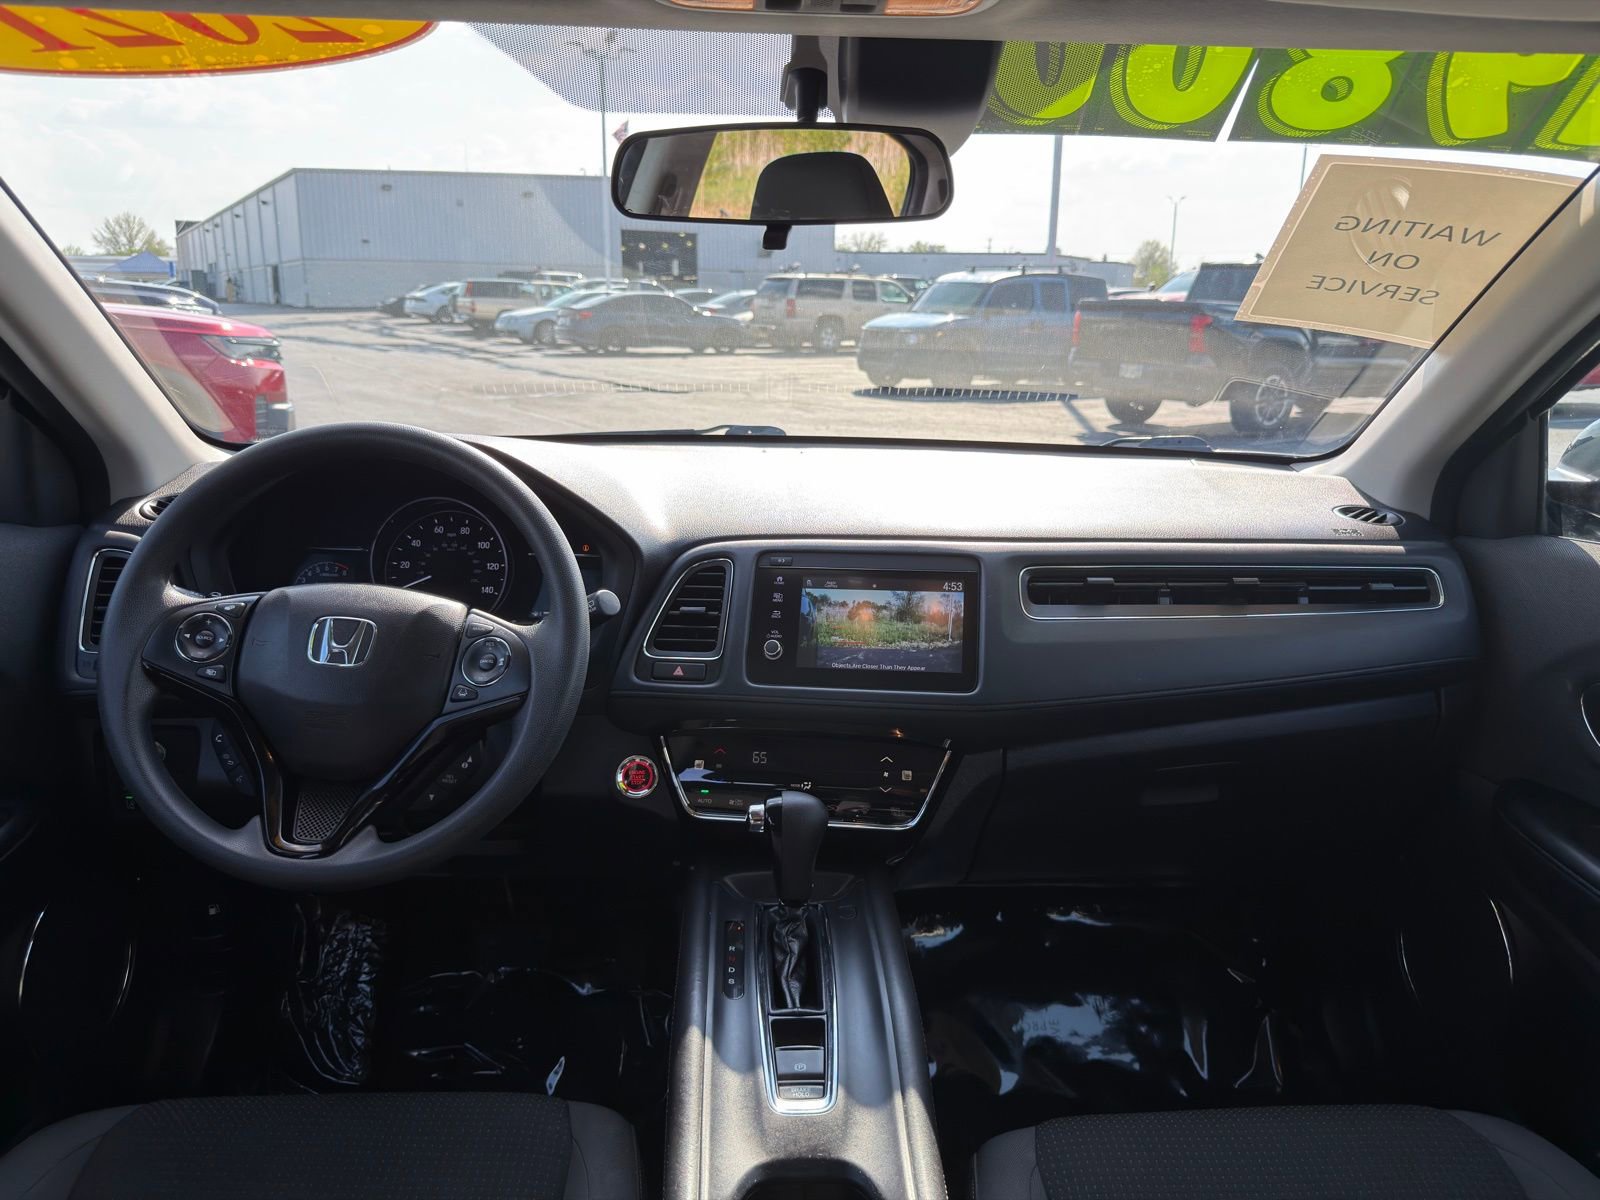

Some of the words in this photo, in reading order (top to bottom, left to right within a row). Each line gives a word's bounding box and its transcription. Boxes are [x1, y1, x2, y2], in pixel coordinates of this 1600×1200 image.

[434, 526, 444, 534] 60
[460, 527, 470, 535] 80
[411, 539, 421, 547] 40
[477, 541, 490, 549] 100
[400, 561, 410, 569] 20
[481, 586, 494, 594] 140
[943, 582, 963, 591] 4:53
[752, 752, 767, 764] 65
